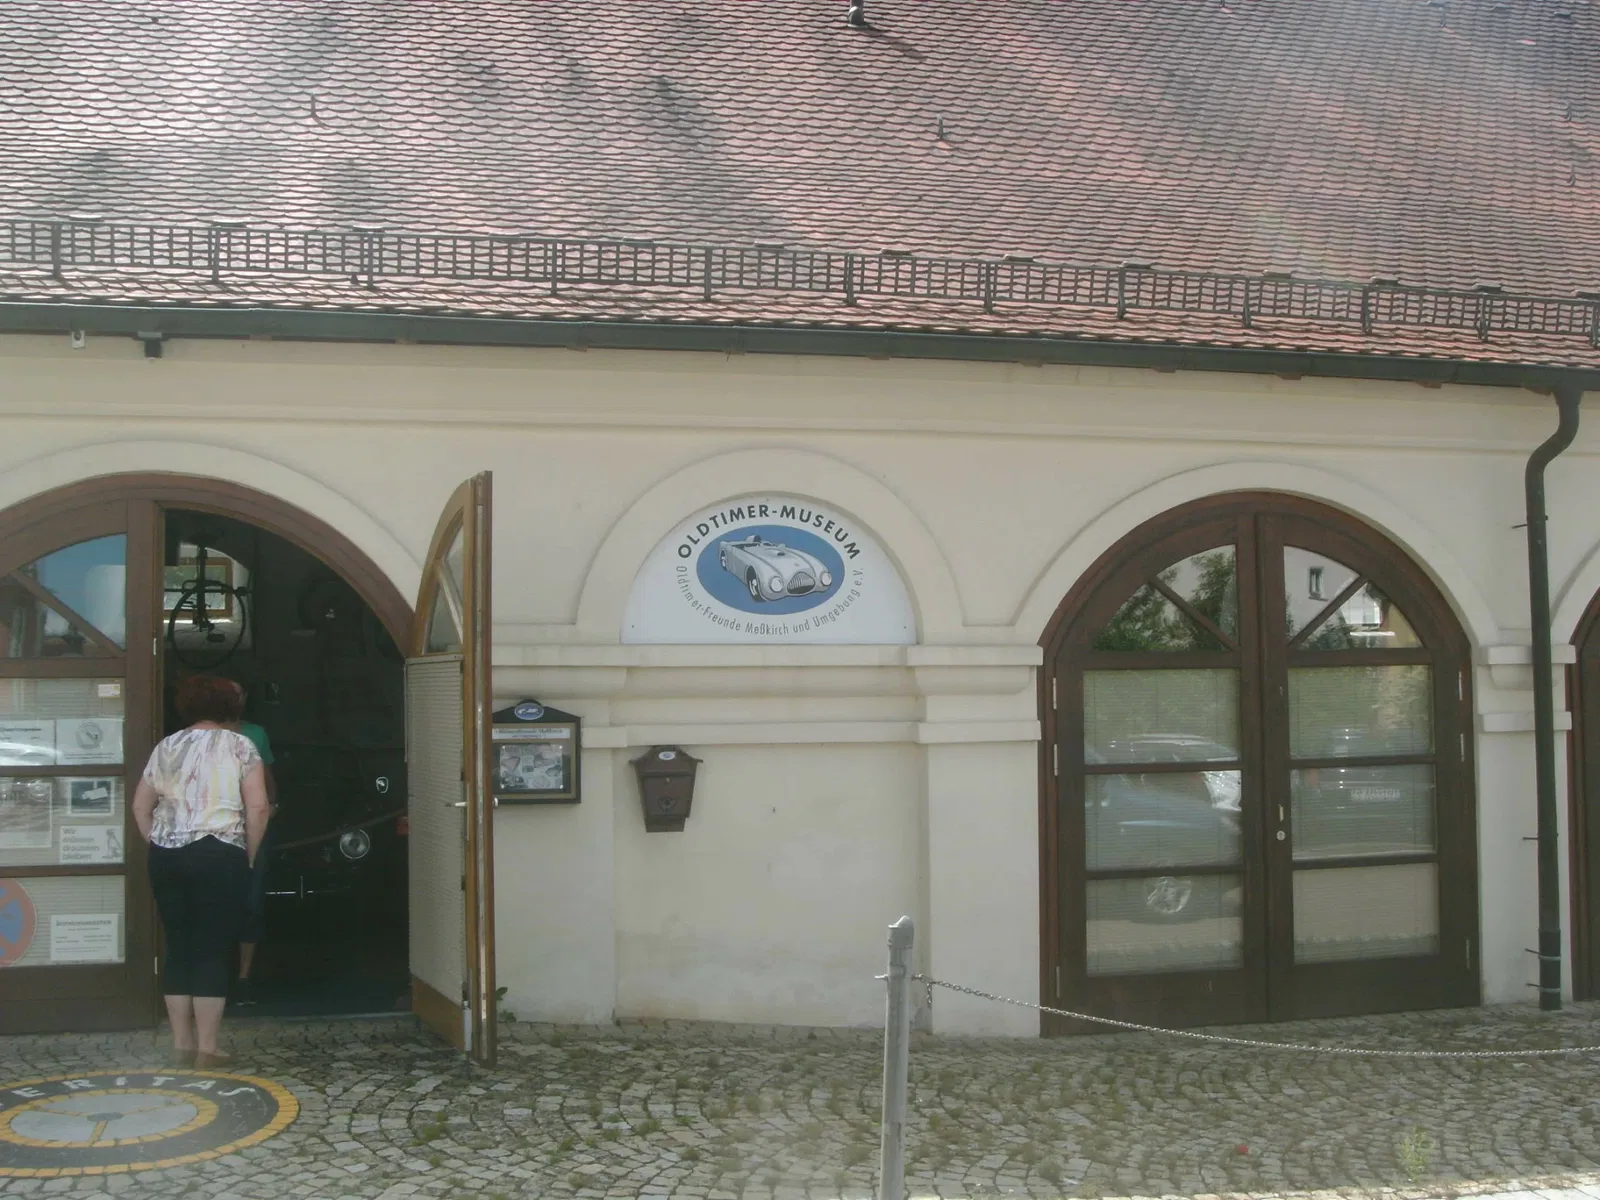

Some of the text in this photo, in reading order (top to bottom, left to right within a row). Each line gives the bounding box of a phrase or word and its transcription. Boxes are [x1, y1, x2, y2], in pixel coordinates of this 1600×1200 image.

[678, 504, 860, 559] OLDTIMER-MUSEUM
[676, 565, 741, 631] Oldtimer-Freunde
[745, 621, 789, 635] Meßkirch
[793, 619, 810, 633] und
[812, 589, 861, 627] Umgebung
[0, 1076, 256, 1110] ERITAS
